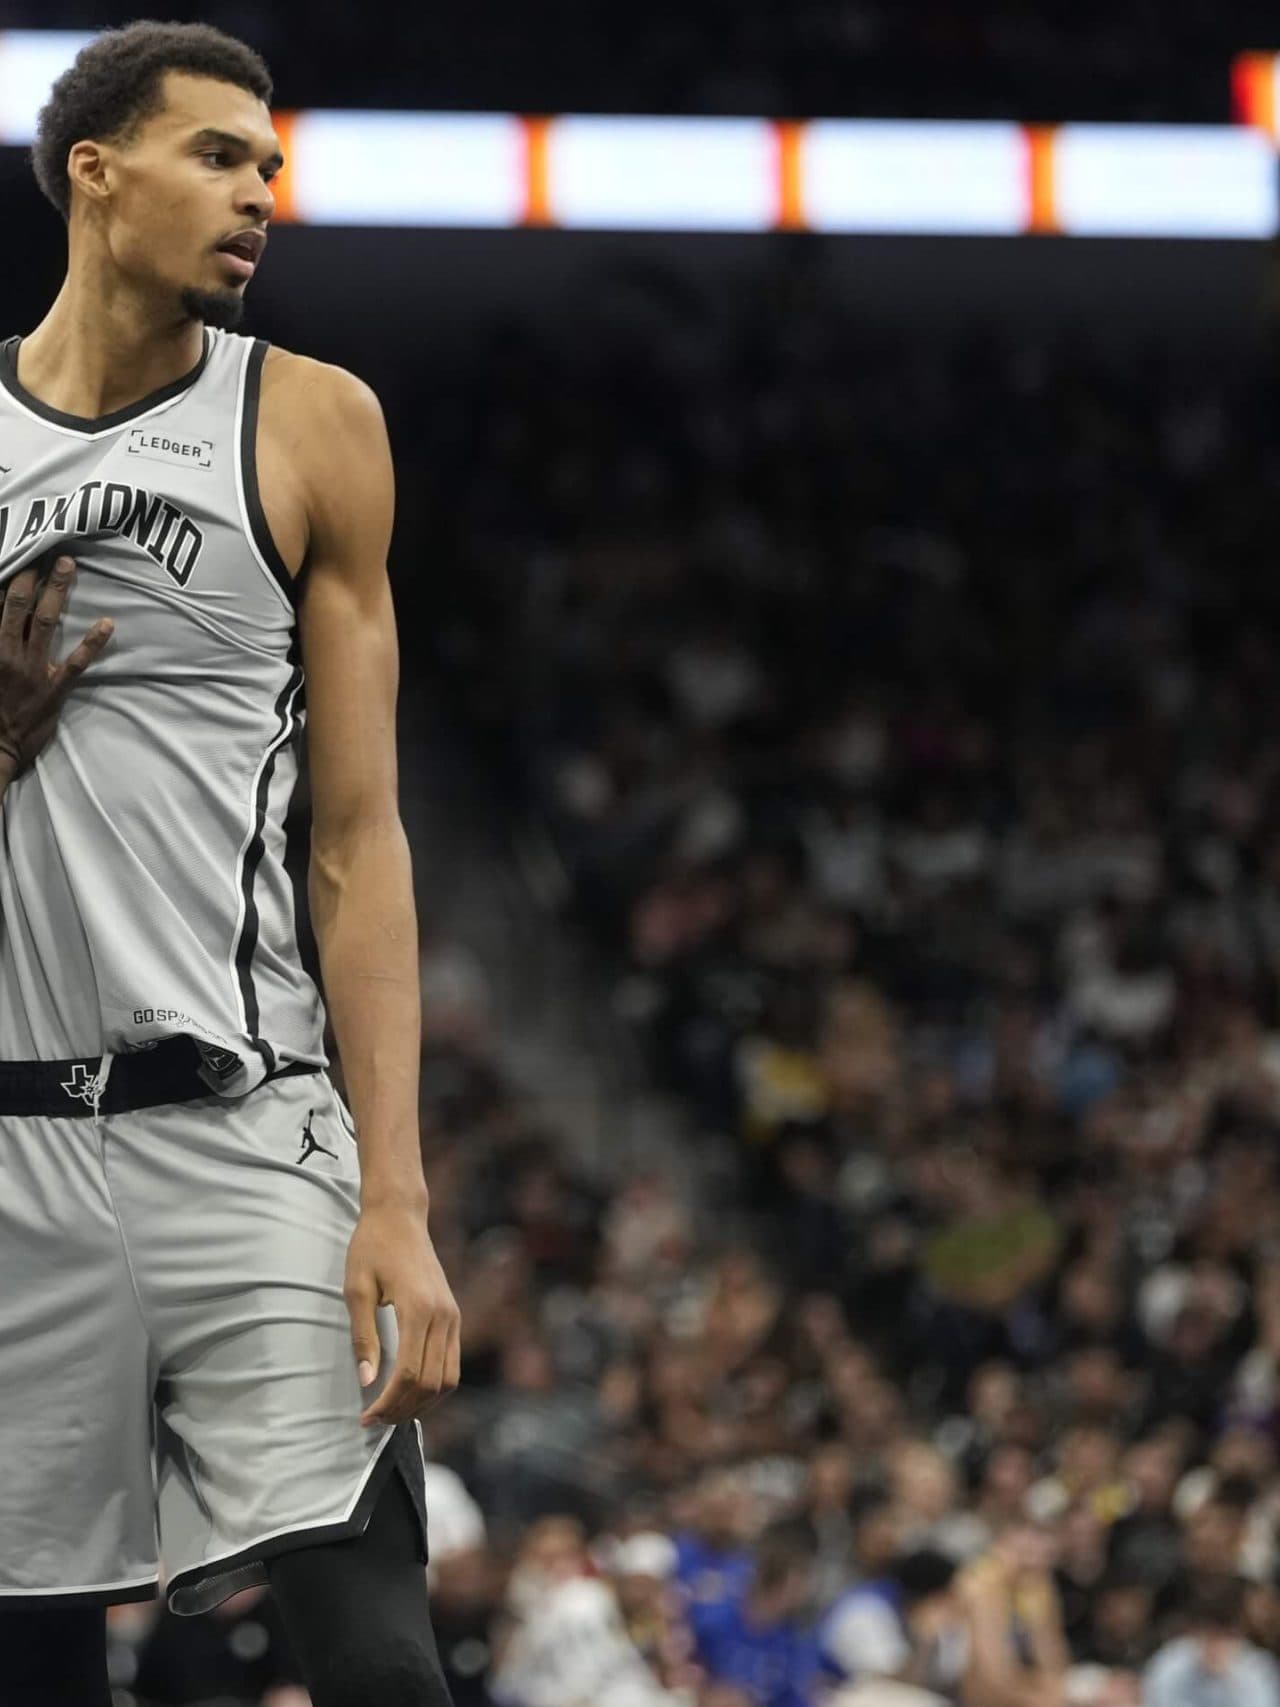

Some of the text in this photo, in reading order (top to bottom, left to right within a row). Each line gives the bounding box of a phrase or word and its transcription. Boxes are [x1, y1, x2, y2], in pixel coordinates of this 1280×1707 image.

[139, 435, 203, 458] LEDGER
[15, 480, 204, 589] ANTONIO
[133, 1008, 154, 1025] GO
